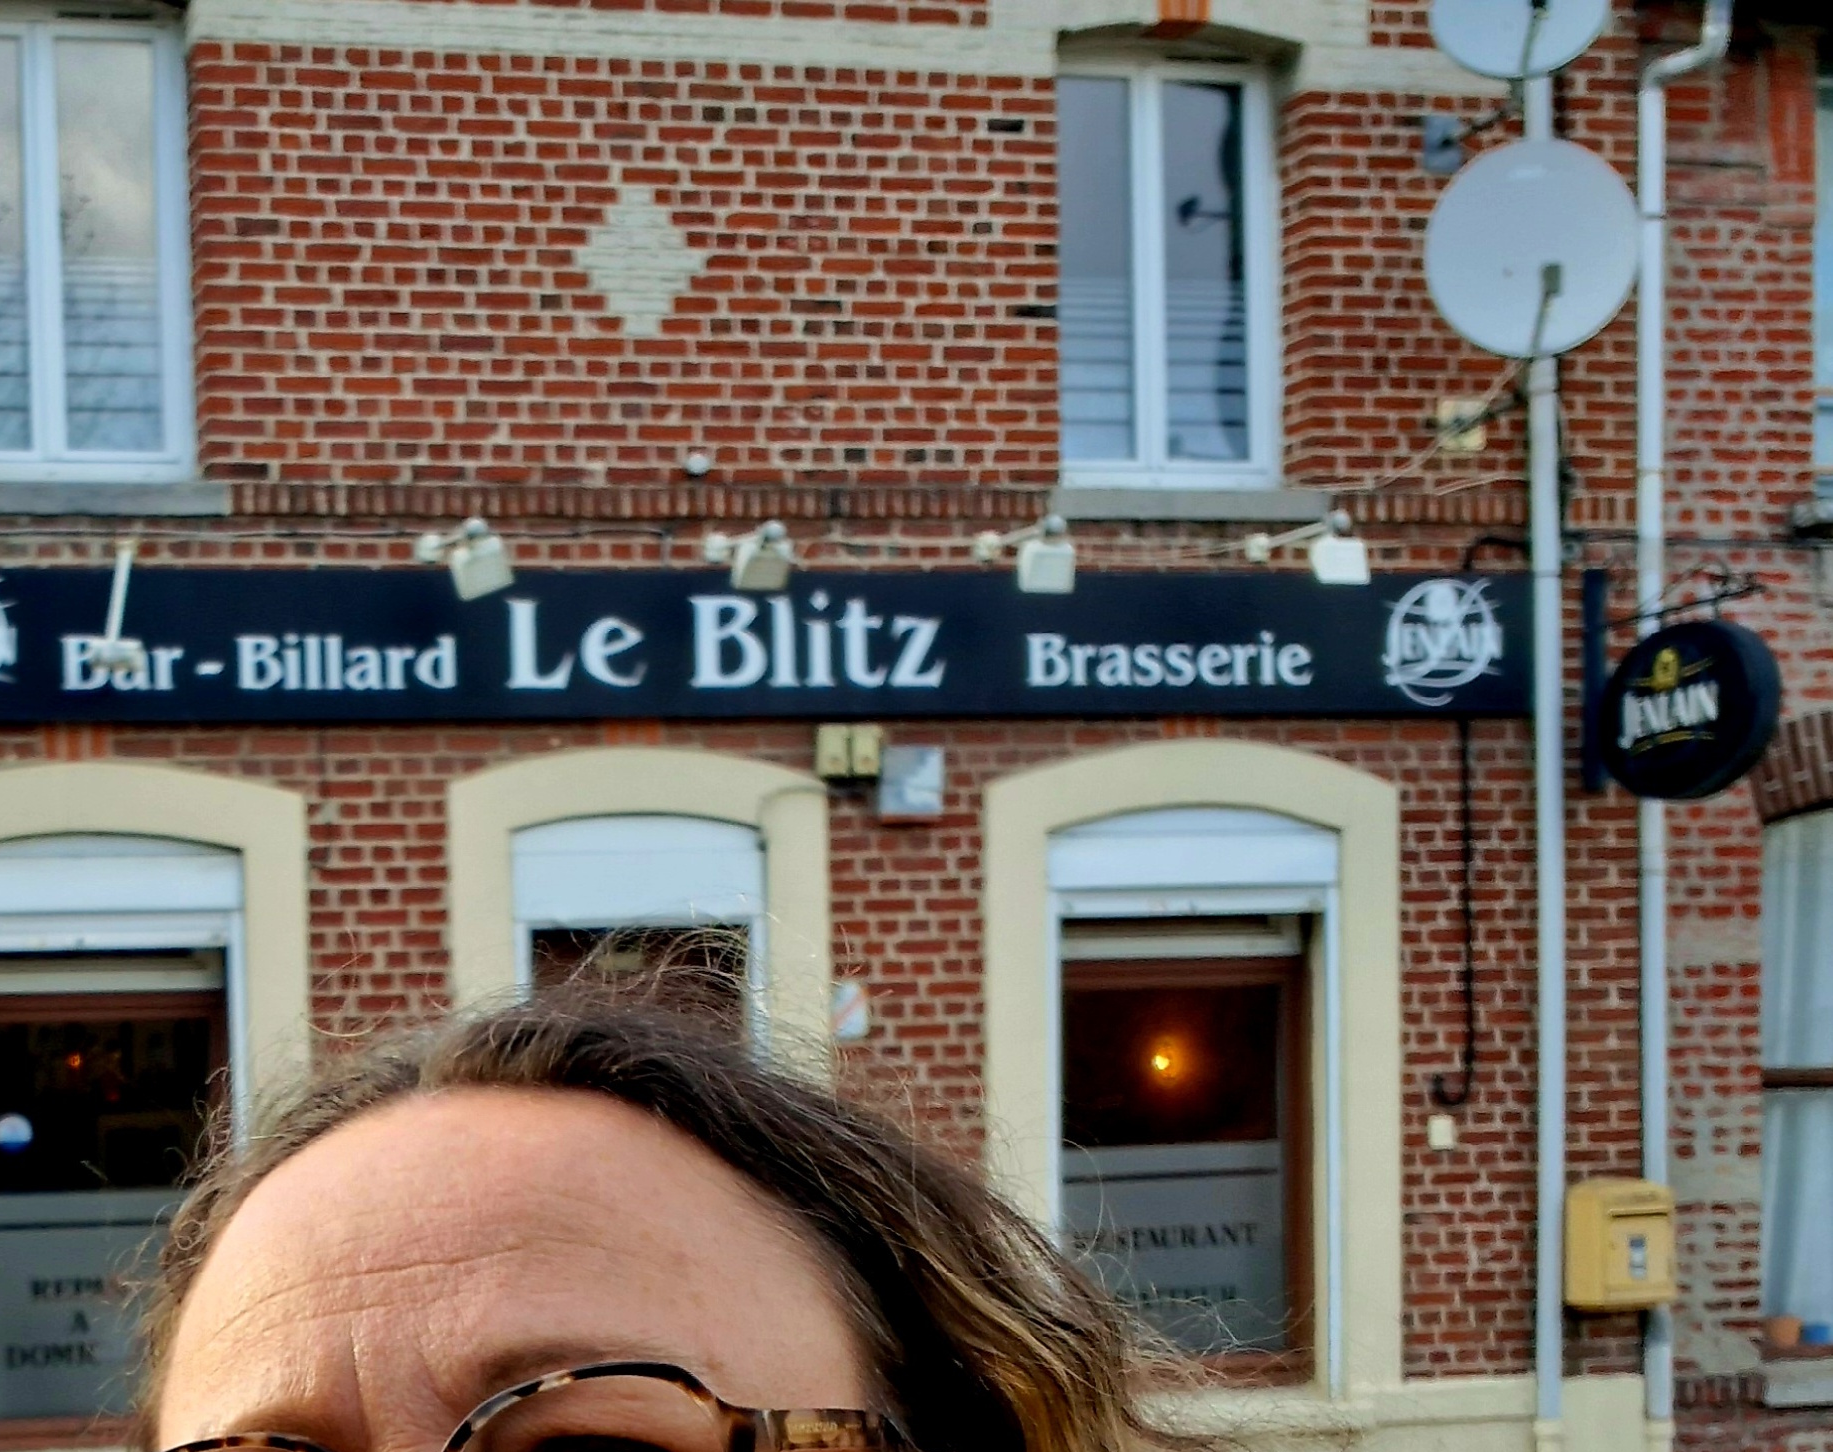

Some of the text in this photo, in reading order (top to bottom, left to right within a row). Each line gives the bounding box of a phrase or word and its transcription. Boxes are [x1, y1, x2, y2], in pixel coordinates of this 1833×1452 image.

[60, 635, 185, 691] Bar
[235, 634, 457, 691] Billard
[506, 590, 945, 690] Le Blitz
[1025, 630, 1314, 688] Brasserie
[1617, 679, 1721, 750] JENLAIN
